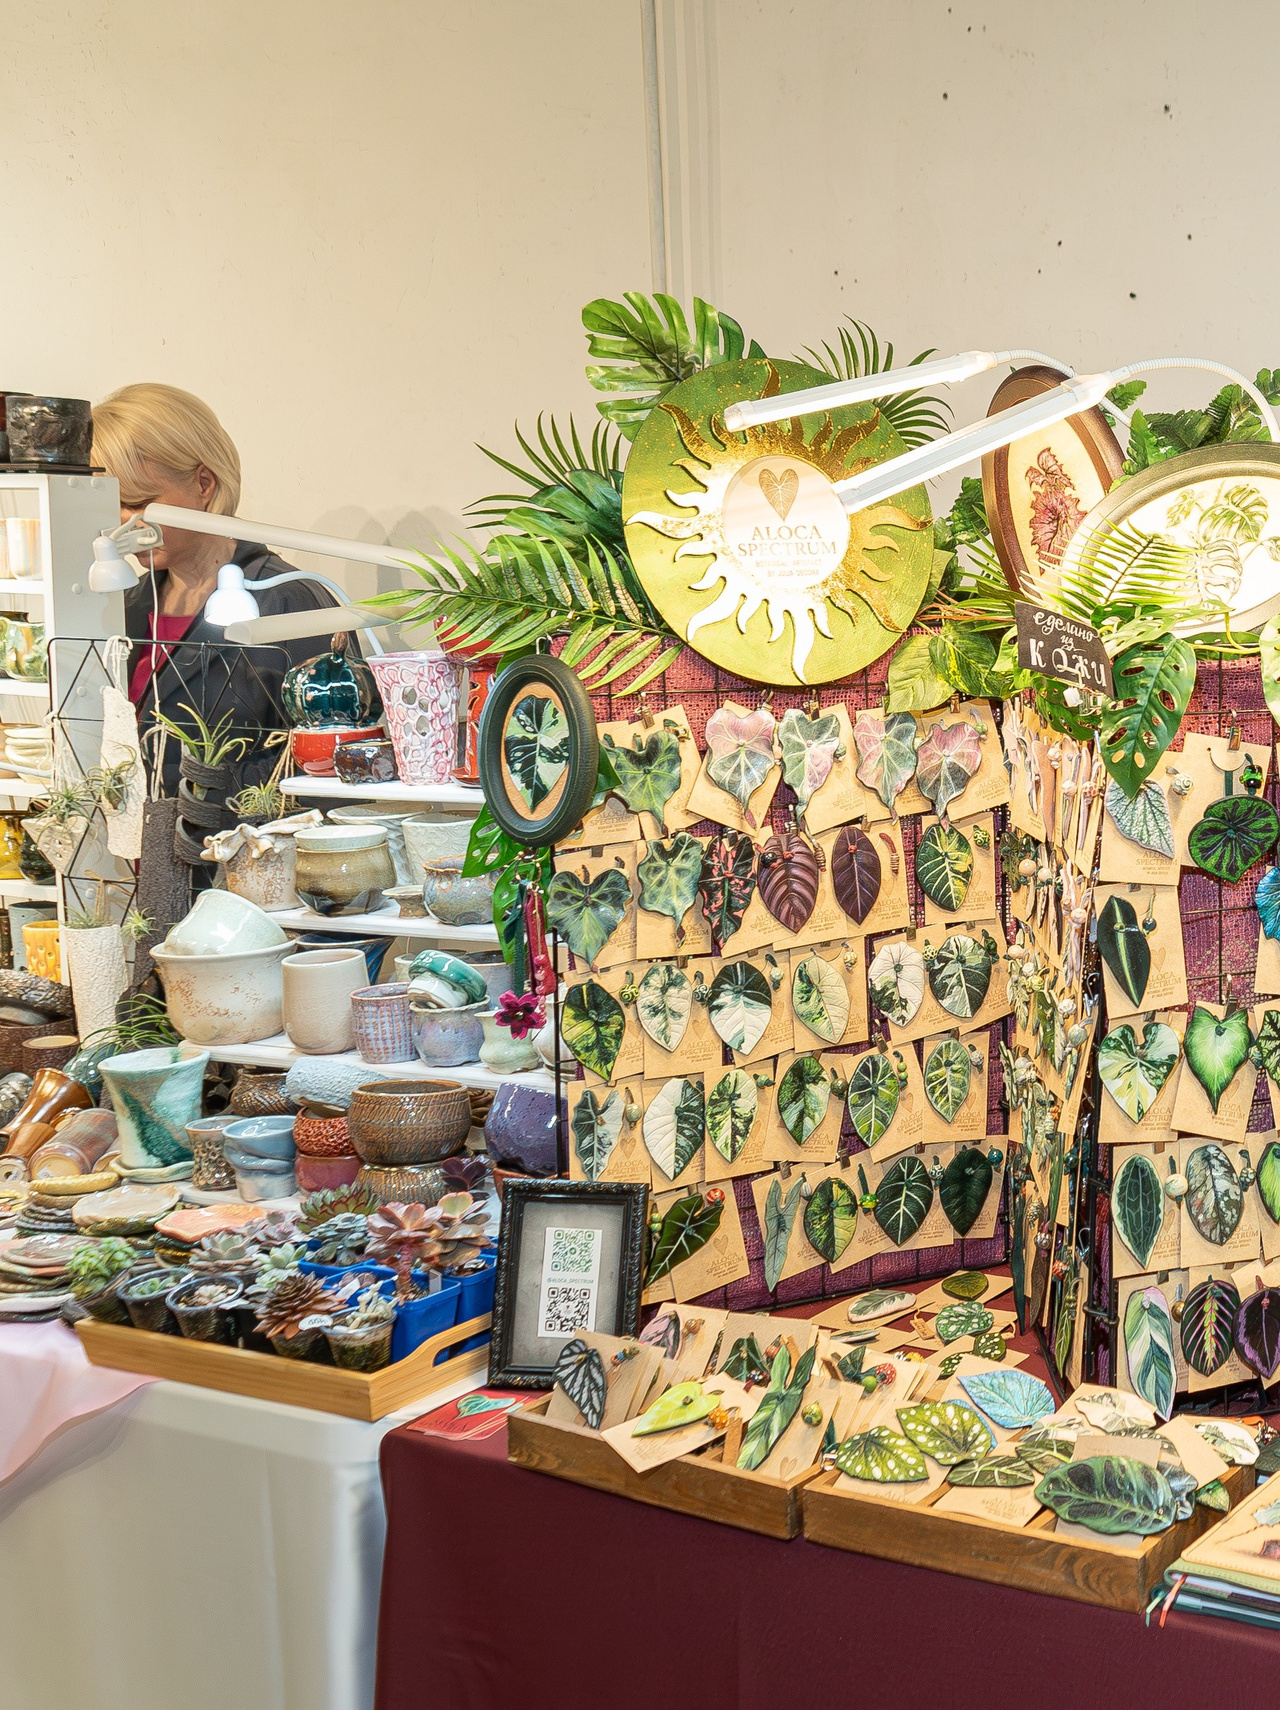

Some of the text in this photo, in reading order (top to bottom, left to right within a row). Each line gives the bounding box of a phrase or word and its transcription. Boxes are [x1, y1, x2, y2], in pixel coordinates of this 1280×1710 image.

[752, 525, 822, 541] ALOCA
[738, 541, 837, 557] SPECTRUM
[1149, 976, 1181, 989] ECTRUM
[706, 1256, 744, 1275] SPECTRUM
[711, 1252, 738, 1268] ALOCA
